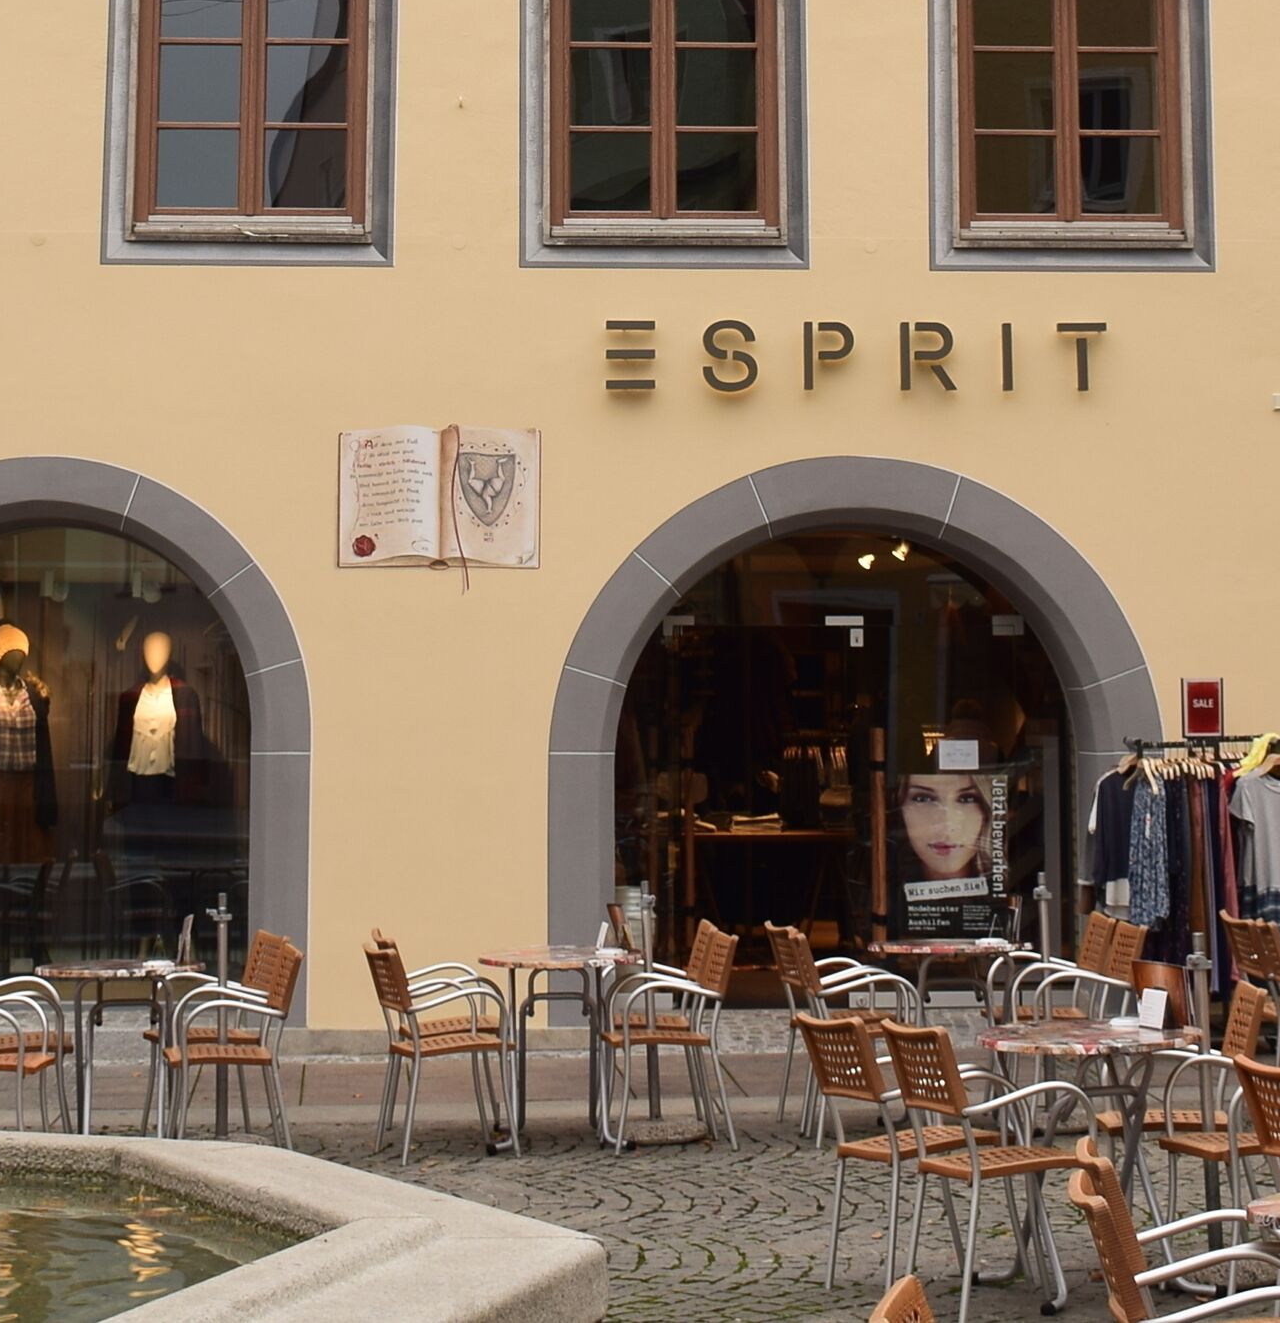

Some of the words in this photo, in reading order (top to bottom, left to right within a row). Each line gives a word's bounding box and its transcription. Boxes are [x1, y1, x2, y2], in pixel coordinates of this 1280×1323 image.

[605, 319, 1108, 393] ESPRIT
[1192, 698, 1214, 709] SALE
[991, 778, 1007, 816] Jetzt
[991, 821, 1008, 899] bewerben!
[907, 888, 924, 897] Wir
[928, 884, 961, 895] suchen
[964, 880, 986, 892] Sie!
[907, 905, 960, 913] Modeberater
[907, 918, 951, 926] Aushilfen
